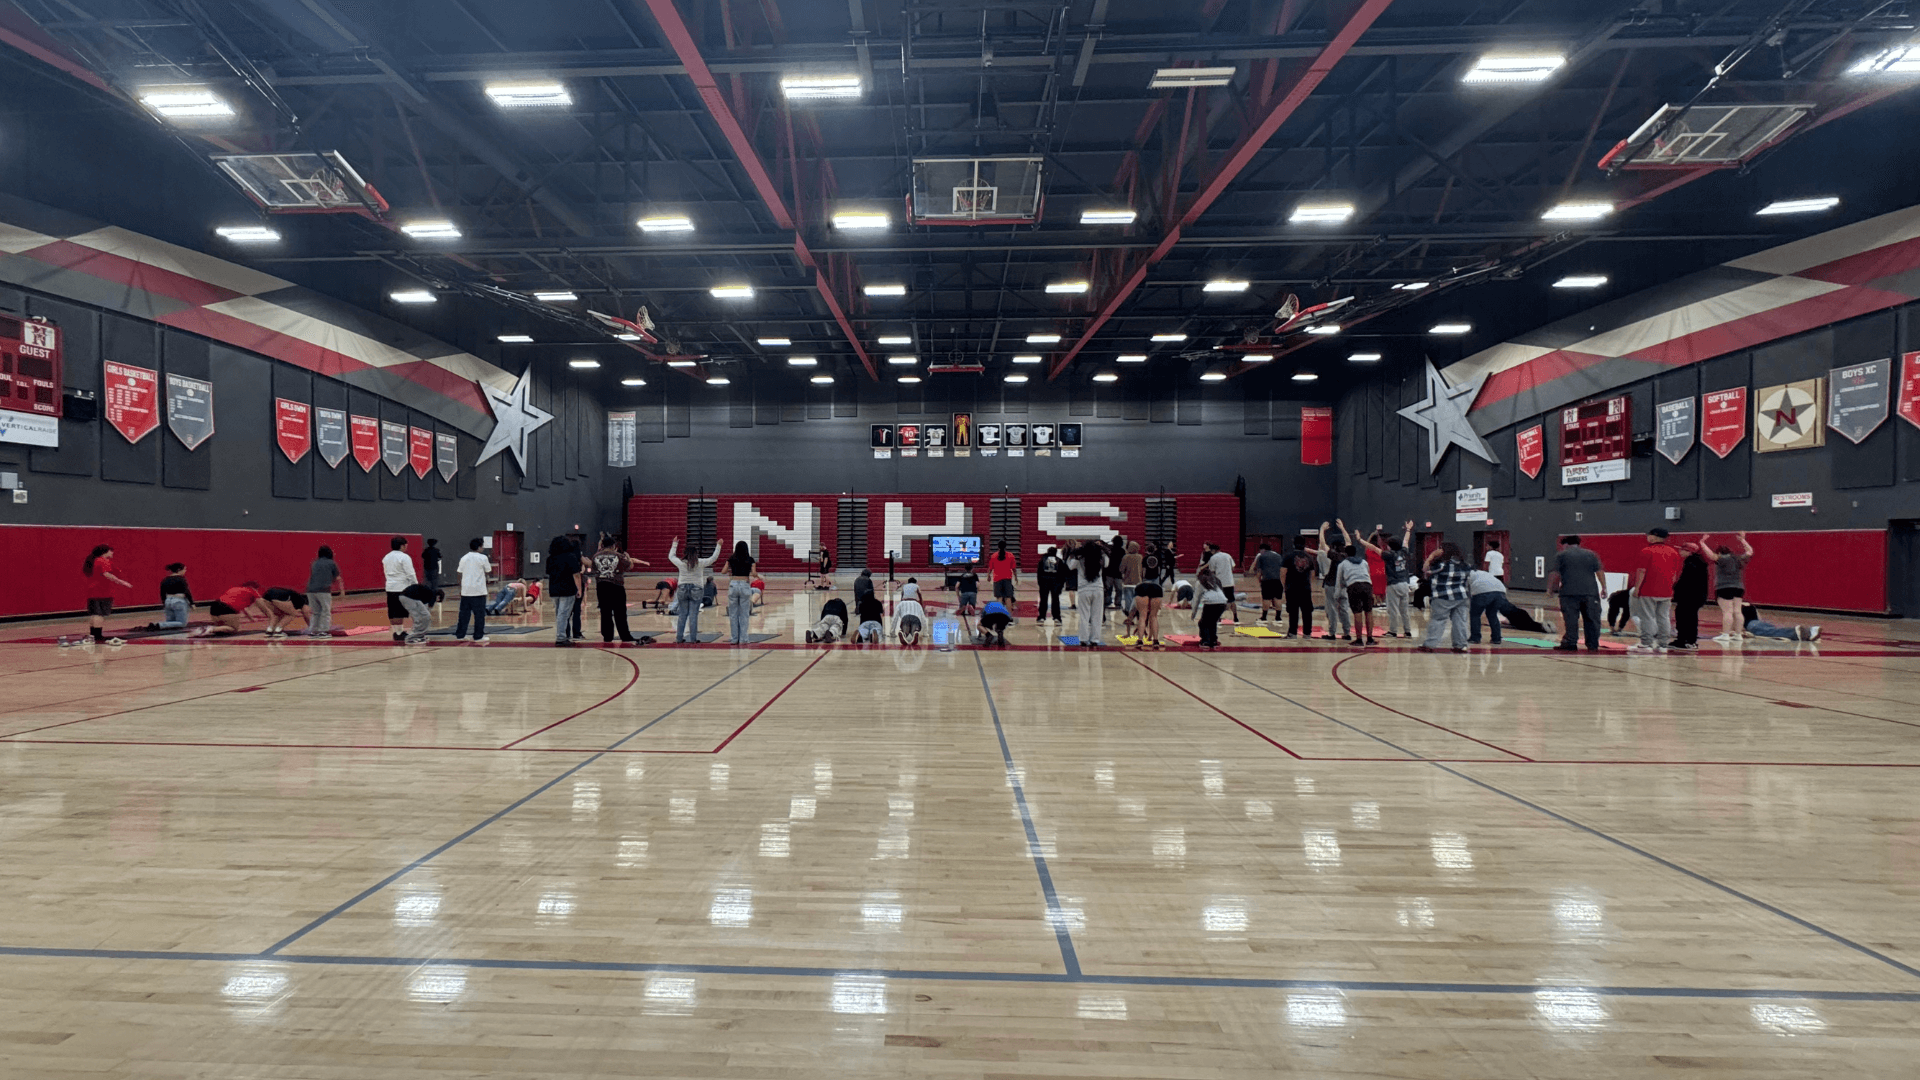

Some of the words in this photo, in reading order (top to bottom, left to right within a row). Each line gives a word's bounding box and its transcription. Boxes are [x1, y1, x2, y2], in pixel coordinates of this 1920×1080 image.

[20, 345, 50, 359] GUEST
[0, 373, 12, 382] OUL
[107, 365, 123, 375] GIRLS
[123, 368, 154, 382] BASKETBALL
[1842, 368, 1864, 379] BOYS
[1865, 365, 1877, 374] XC
[33, 379, 54, 388] FOULS
[169, 377, 182, 387] BOYS
[182, 379, 210, 393] BASKETBALL
[1708, 391, 1740, 403] SOFTBALL
[33, 403, 55, 413] SCORE
[1661, 401, 1689, 413] BASEBALL
[1776, 408, 1797, 427] N
[904, 430, 914, 438] 40
[1463, 491, 1482, 499] Priority
